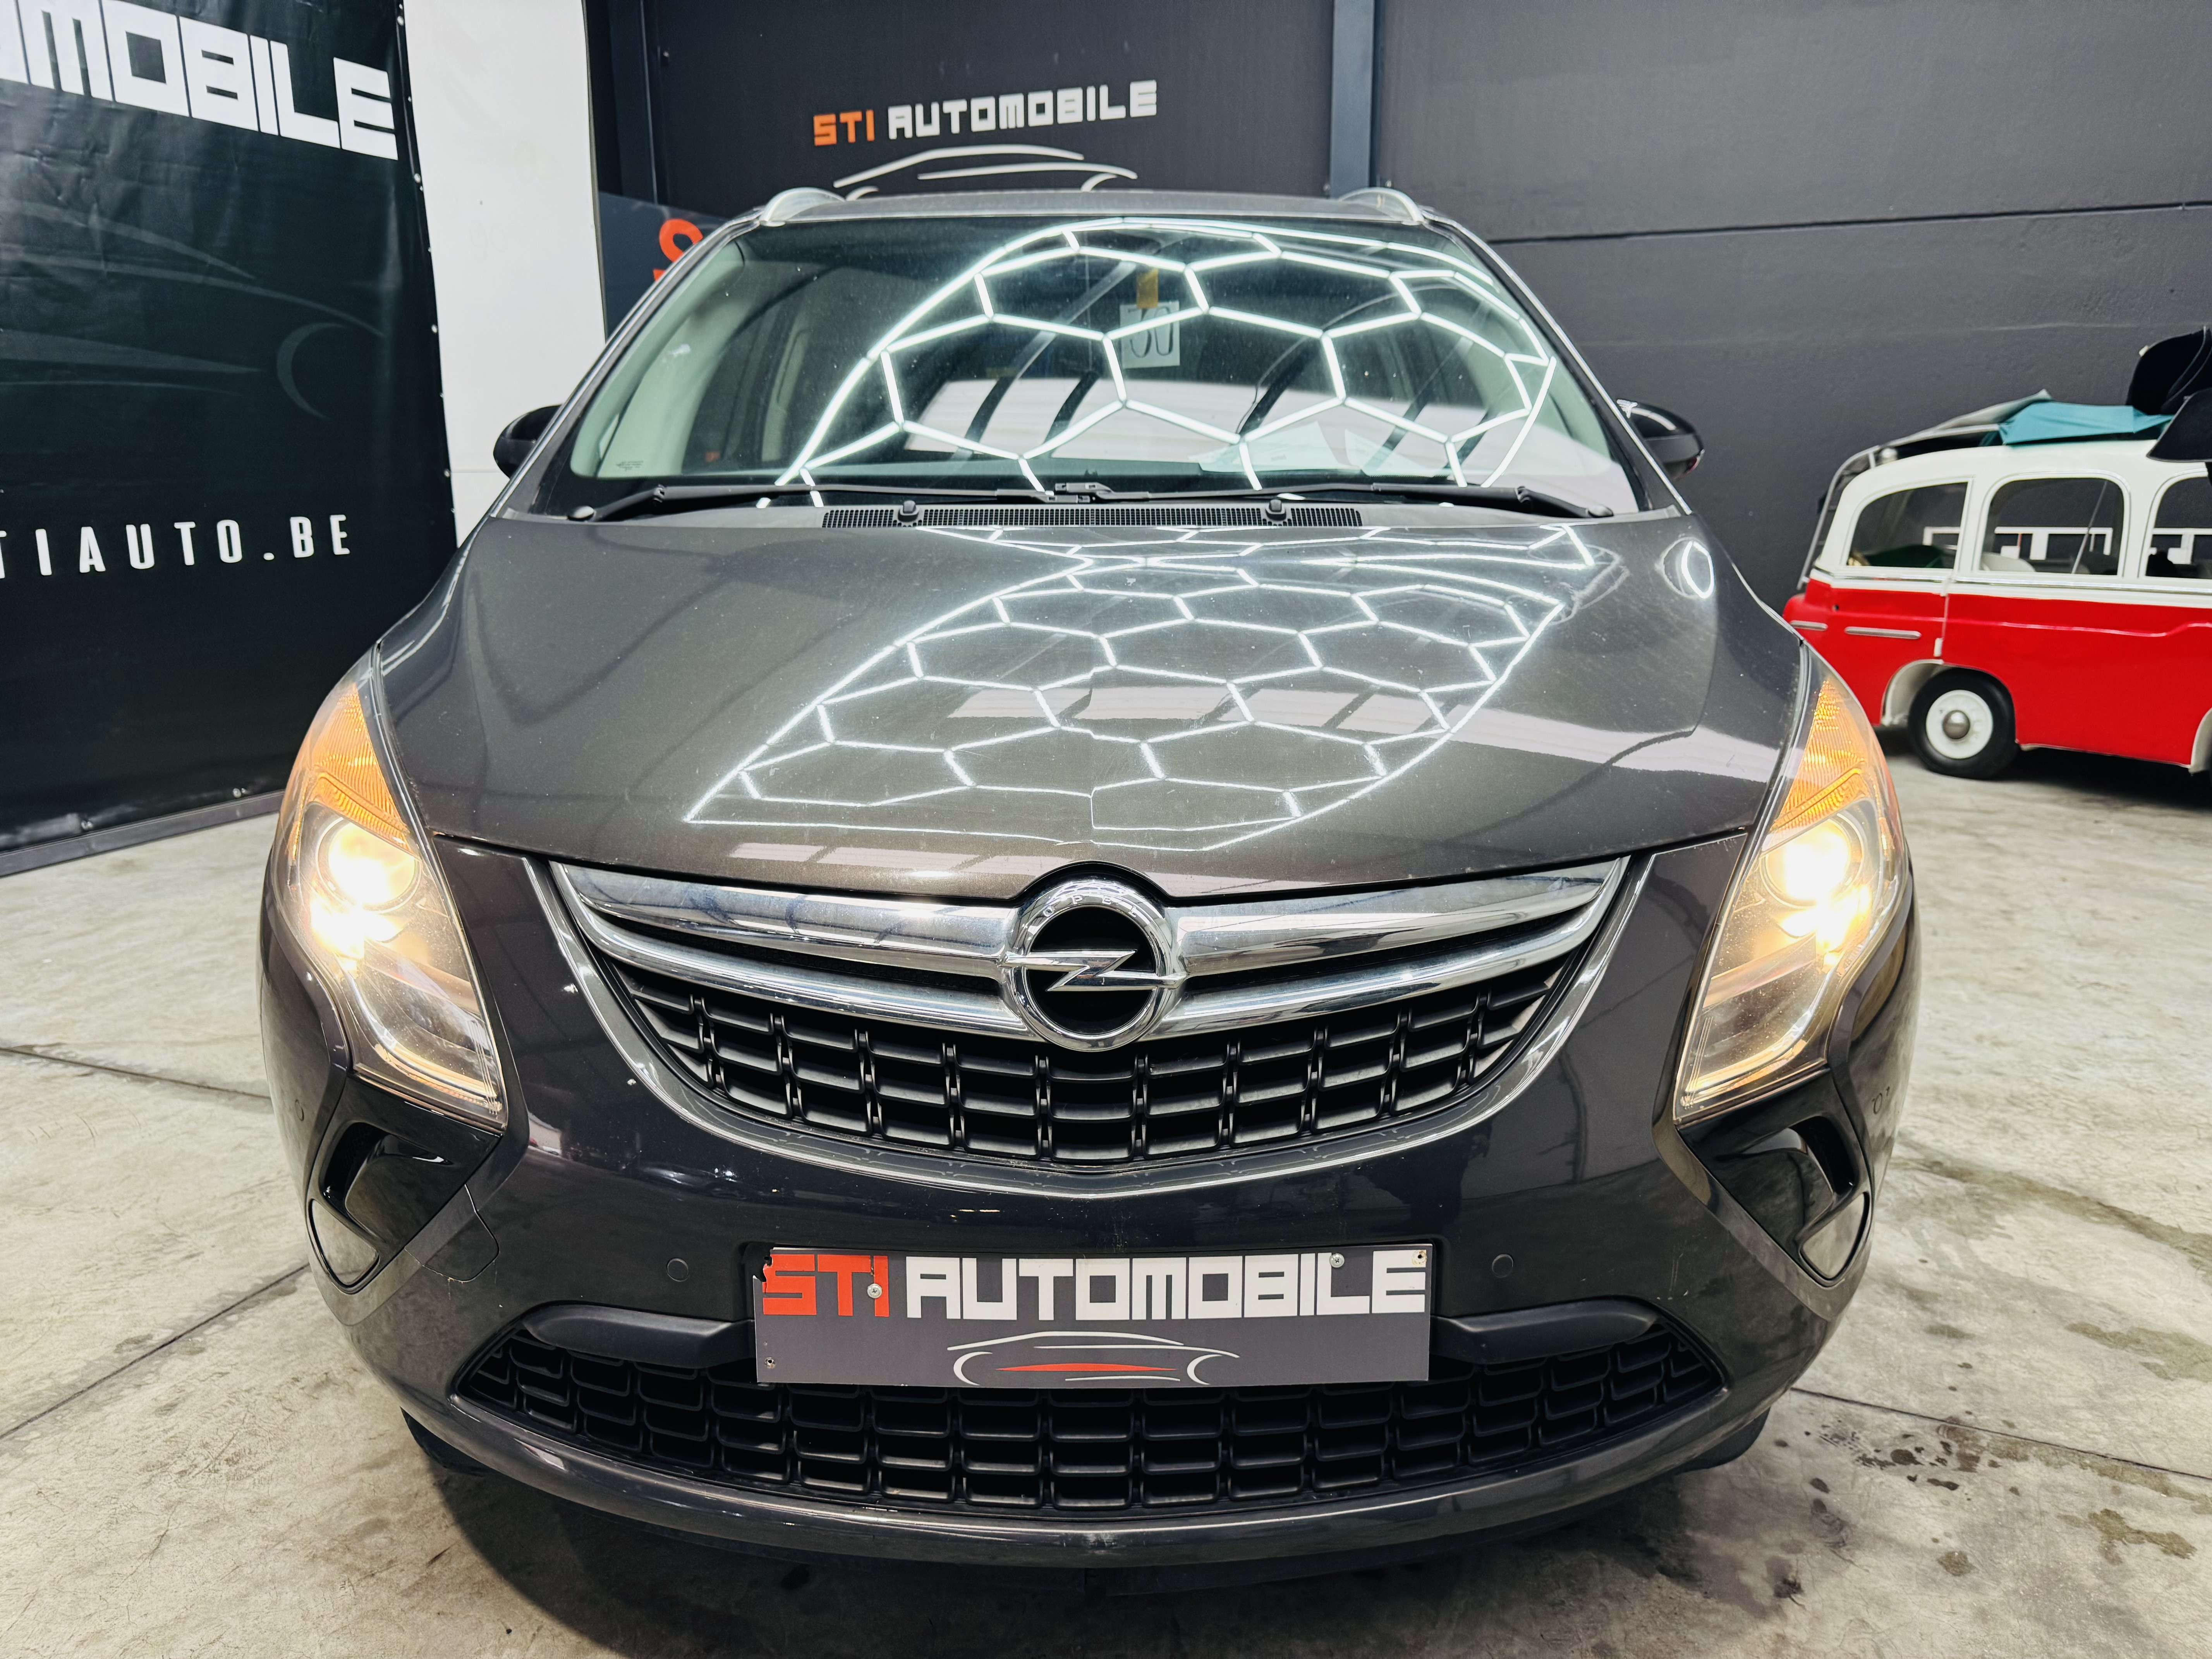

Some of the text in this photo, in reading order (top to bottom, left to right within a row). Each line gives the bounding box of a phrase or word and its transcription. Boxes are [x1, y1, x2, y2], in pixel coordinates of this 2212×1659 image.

[814, 79, 1157, 146] STI AUTOMOBILE
[1043, 895, 1137, 918] OPEL
[762, 1250, 1425, 1321] STI AUTOMOBILE
